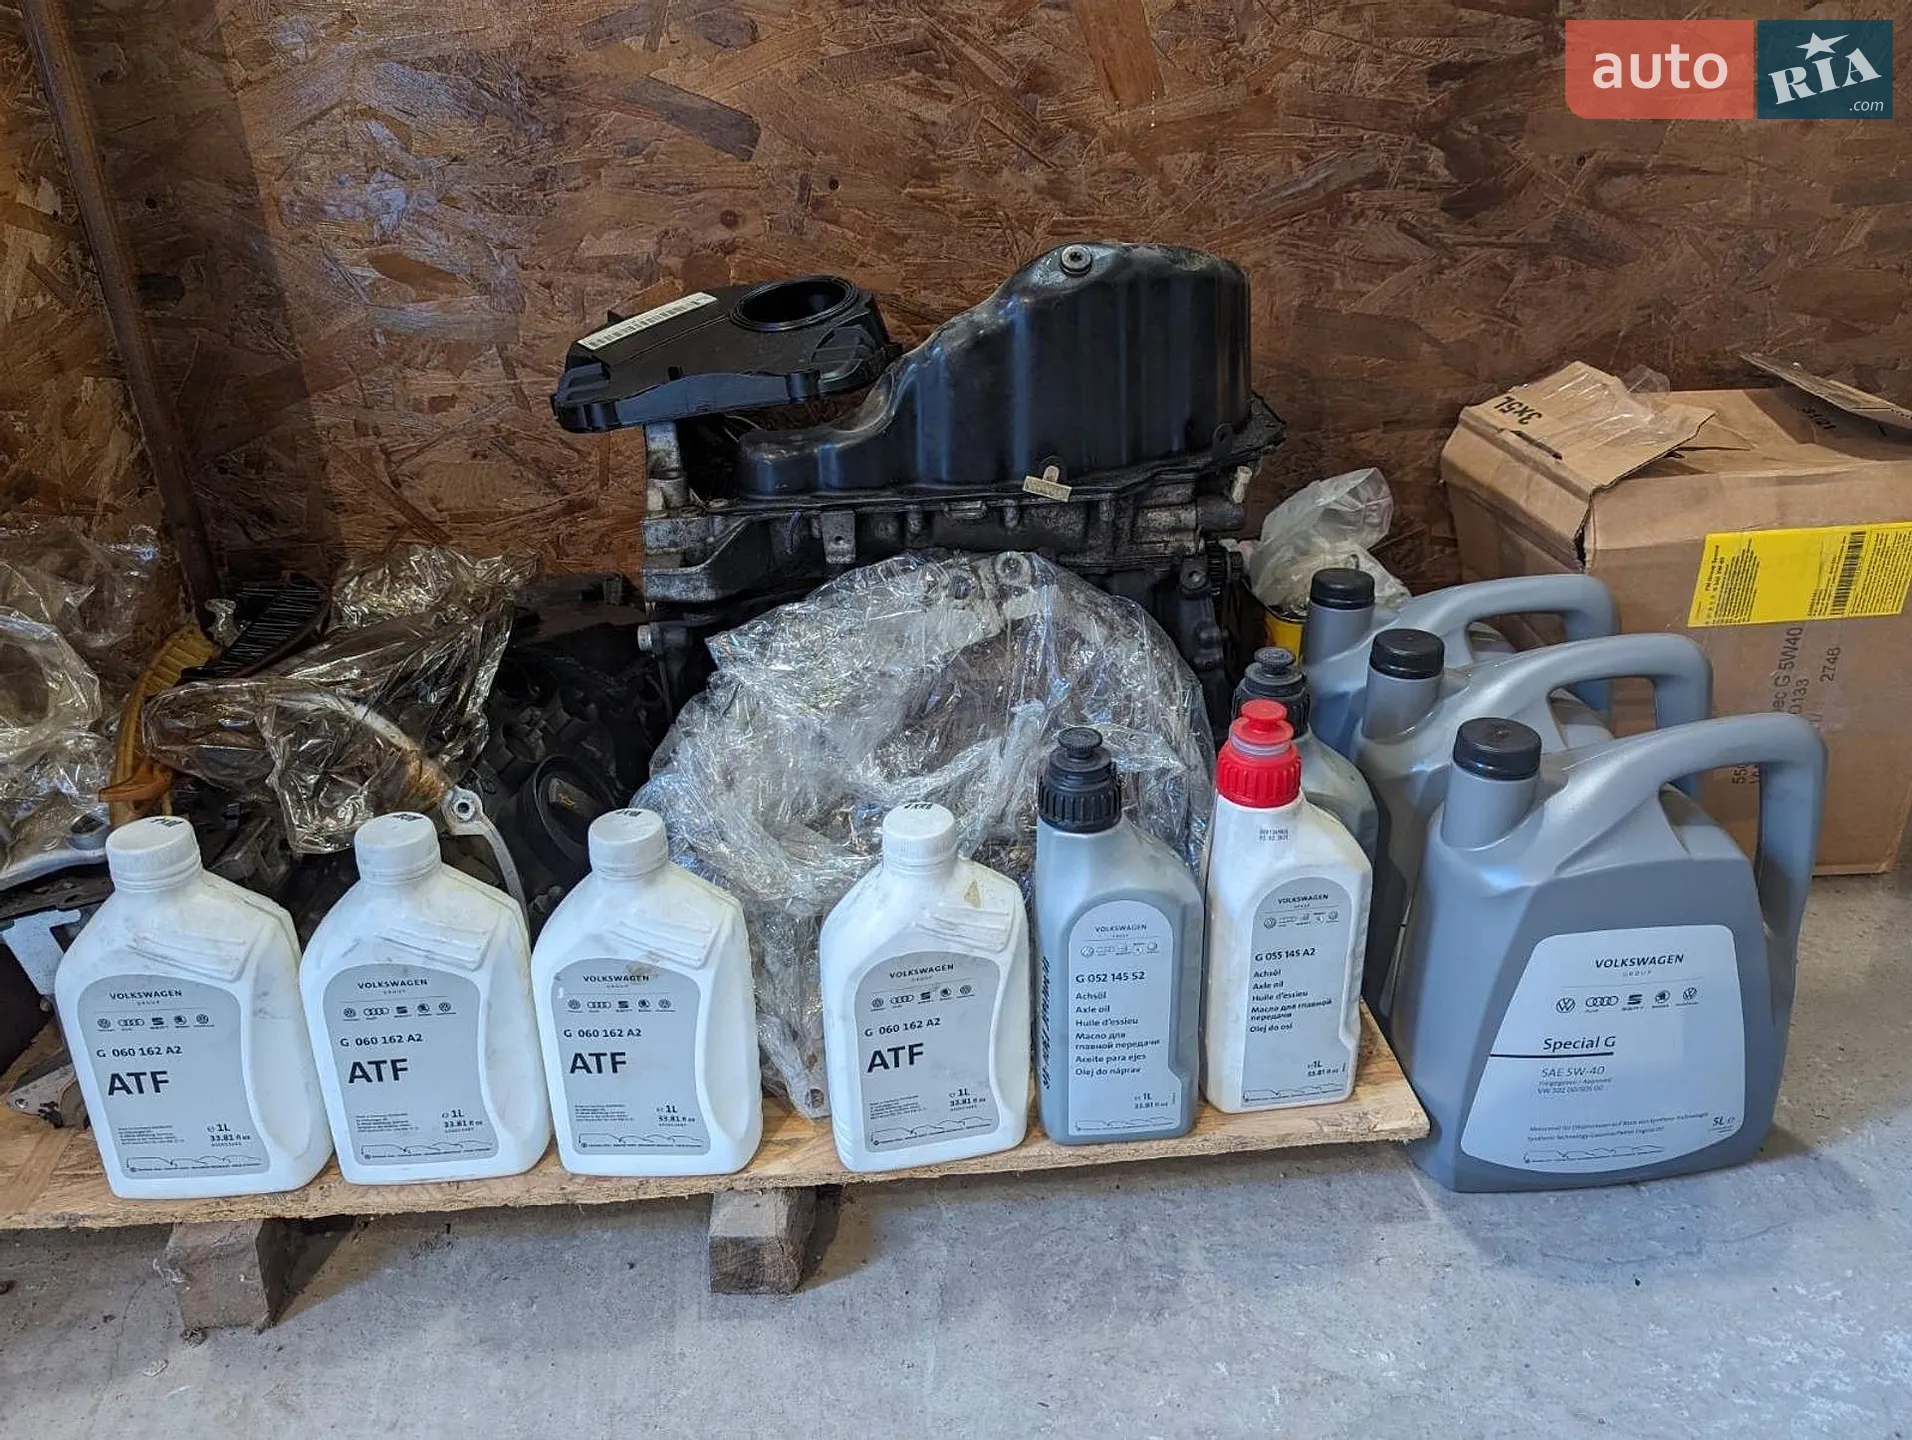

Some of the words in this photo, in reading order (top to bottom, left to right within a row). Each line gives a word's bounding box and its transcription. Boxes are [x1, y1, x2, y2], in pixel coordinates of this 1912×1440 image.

[1779, 627, 1803, 671] 5W40
[1277, 893, 1329, 905] VOLKSWAGEN
[1095, 923, 1147, 932] VOLKSWAGEN
[1255, 953, 1263, 961] G
[1265, 951, 1282, 960] 055
[1285, 948, 1301, 958] 145
[1302, 947, 1316, 957] A2
[1595, 953, 1685, 969] VOLKSWAGEN
[889, 963, 955, 979] VOLKSWAGEN
[583, 975, 650, 983] VOLKSWAGEN
[1075, 974, 1085, 983] G
[1087, 973, 1108, 983] 052
[1112, 972, 1129, 982] 145
[357, 978, 428, 990] VOLKSWAGEN
[1252, 981, 1272, 990] Axle
[109, 989, 183, 1000] VOLKSWAGEN
[1075, 991, 1107, 1000] Achsöl
[1252, 994, 1274, 1002] Huile
[1075, 1006, 1097, 1014] Axle
[1098, 1005, 1110, 1014] oil
[865, 1028, 873, 1037] G
[879, 1025, 900, 1035] 060
[903, 1021, 923, 1031] 162
[926, 1017, 941, 1027] A2
[1075, 1019, 1100, 1027] Huile
[563, 1029, 573, 1038] G
[578, 1029, 600, 1038] 060
[602, 1029, 624, 1037] 162
[627, 1029, 642, 1037] A2
[1075, 1032, 1106, 1040] Масло
[340, 1038, 349, 1047] G
[355, 1036, 378, 1046] 060
[382, 1035, 404, 1044] 162
[407, 1033, 423, 1043] A2
[1543, 1035, 1600, 1053] Special
[1603, 1035, 1617, 1048] G
[96, 1049, 106, 1058] G
[112, 1048, 136, 1057] 060
[139, 1046, 162, 1056] 162
[166, 1045, 183, 1055] A2
[569, 1051, 627, 1075] ATF
[866, 1042, 925, 1073] ATF
[1075, 1055, 1104, 1063] Aceite
[1106, 1055, 1126, 1064] para
[1128, 1053, 1147, 1062] ejes
[348, 1058, 408, 1084] ATF
[1075, 1068, 1094, 1078] Olej
[1096, 1067, 1108, 1076] do
[1541, 1067, 1563, 1078] SAE
[1565, 1064, 1606, 1077] 5W-40
[107, 1070, 169, 1096] ATF
[958, 1088, 970, 1097] 1L
[451, 1109, 465, 1118] 1L
[665, 1105, 677, 1114] 1L
[1712, 1116, 1725, 1127] 5L
[216, 1123, 230, 1132] 1L
